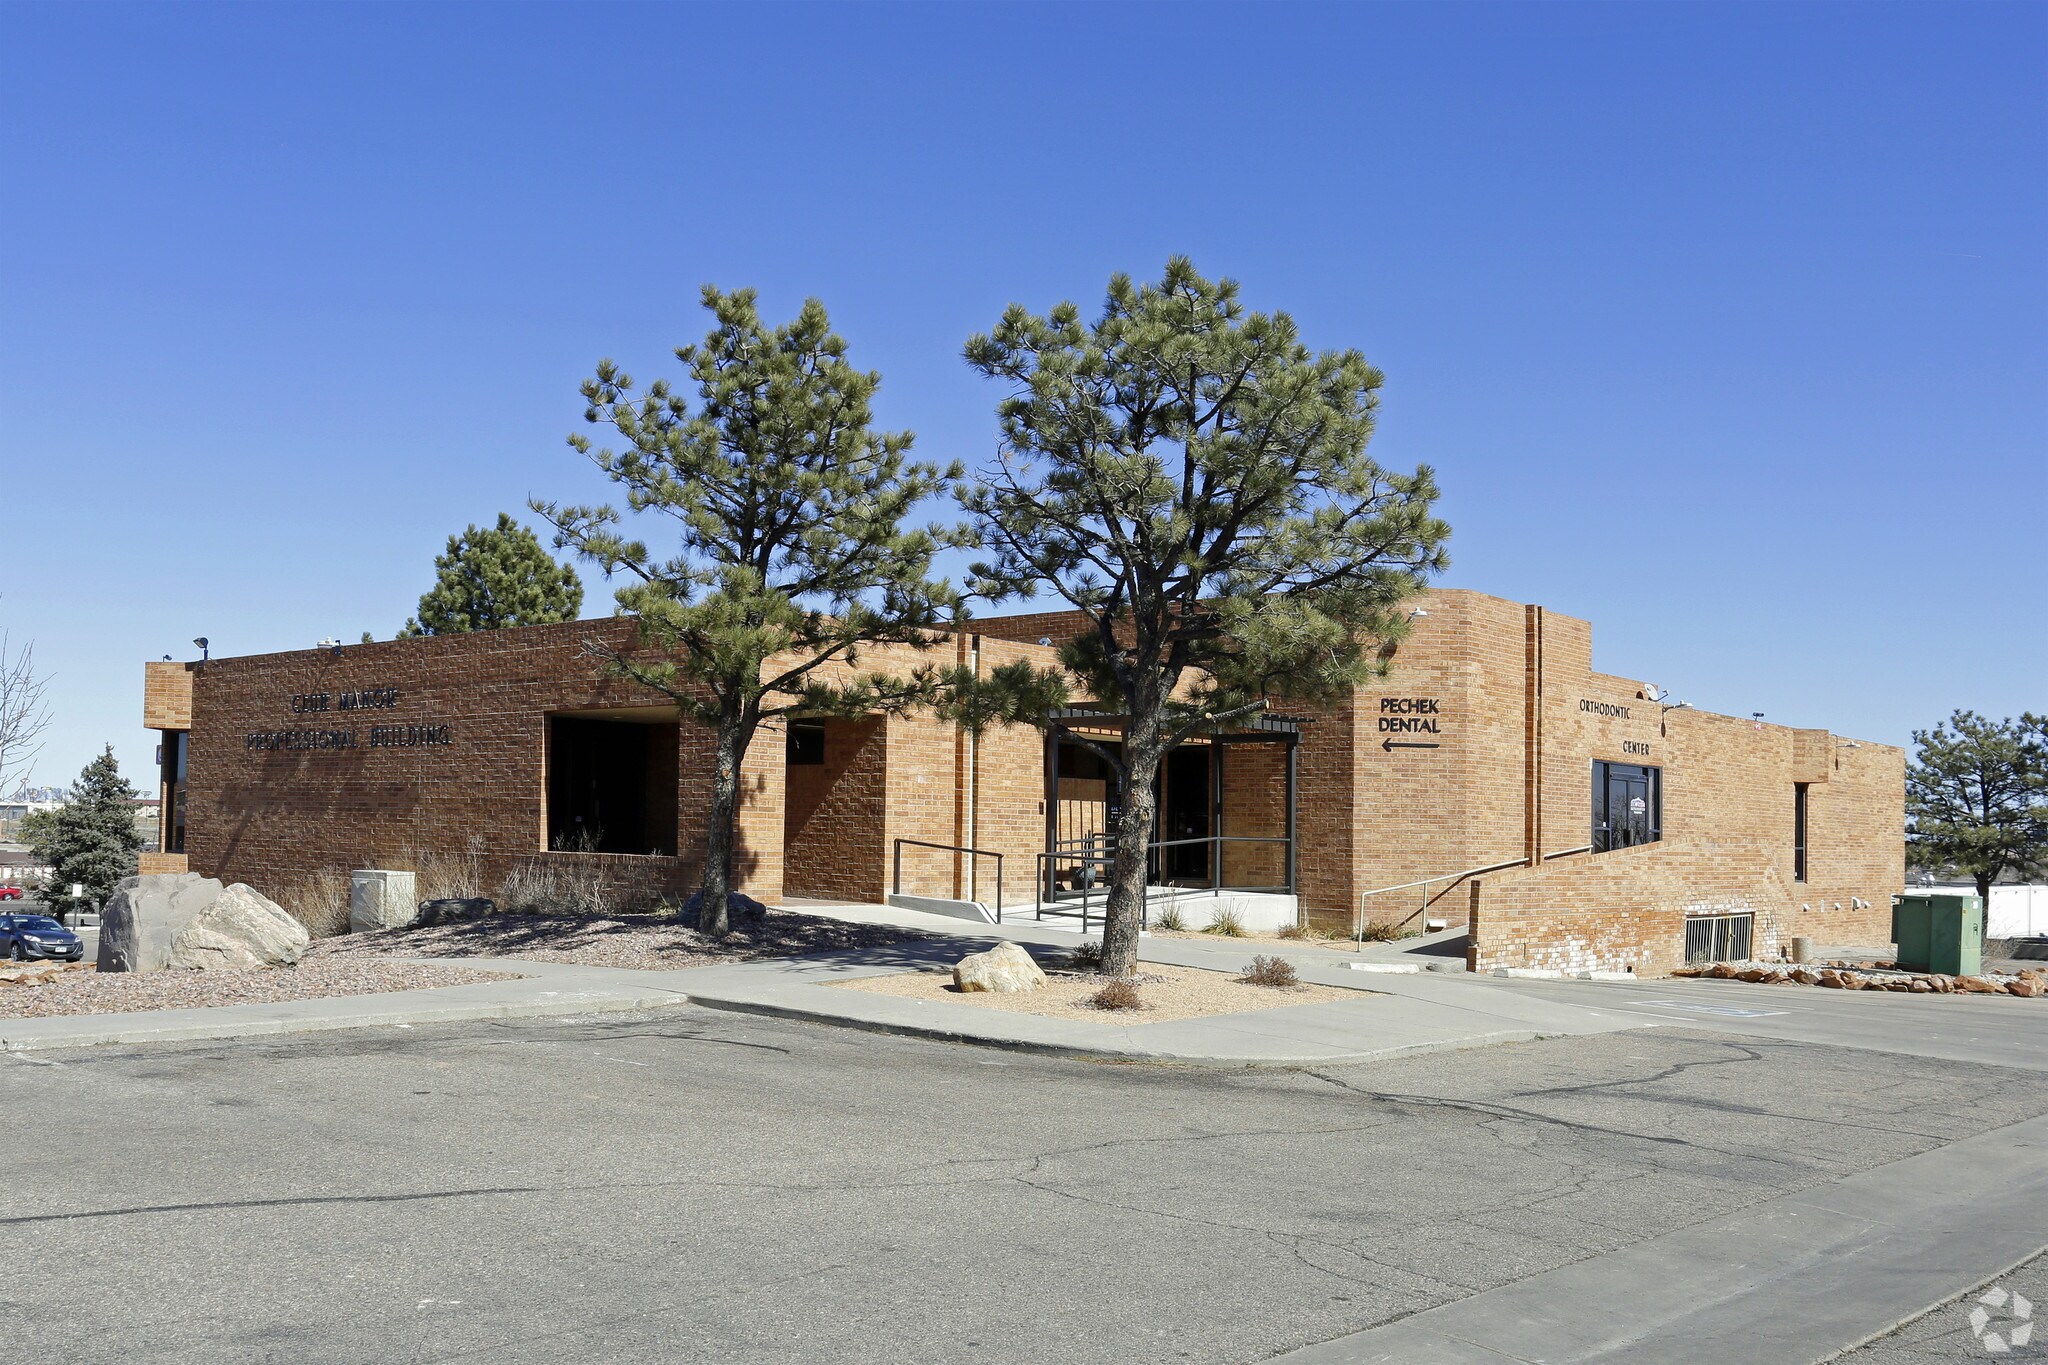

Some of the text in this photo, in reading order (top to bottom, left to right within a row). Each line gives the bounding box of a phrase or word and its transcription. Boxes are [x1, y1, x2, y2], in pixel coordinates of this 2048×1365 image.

[340, 687, 397, 710] MANOR
[1381, 699, 1440, 714] PECHEK
[1579, 699, 1630, 719] ORTHODONTIC
[1379, 717, 1441, 733] DENTAL
[247, 724, 452, 750] PROFESSIONAL BUILDING
[1623, 740, 1650, 755] CENTER
